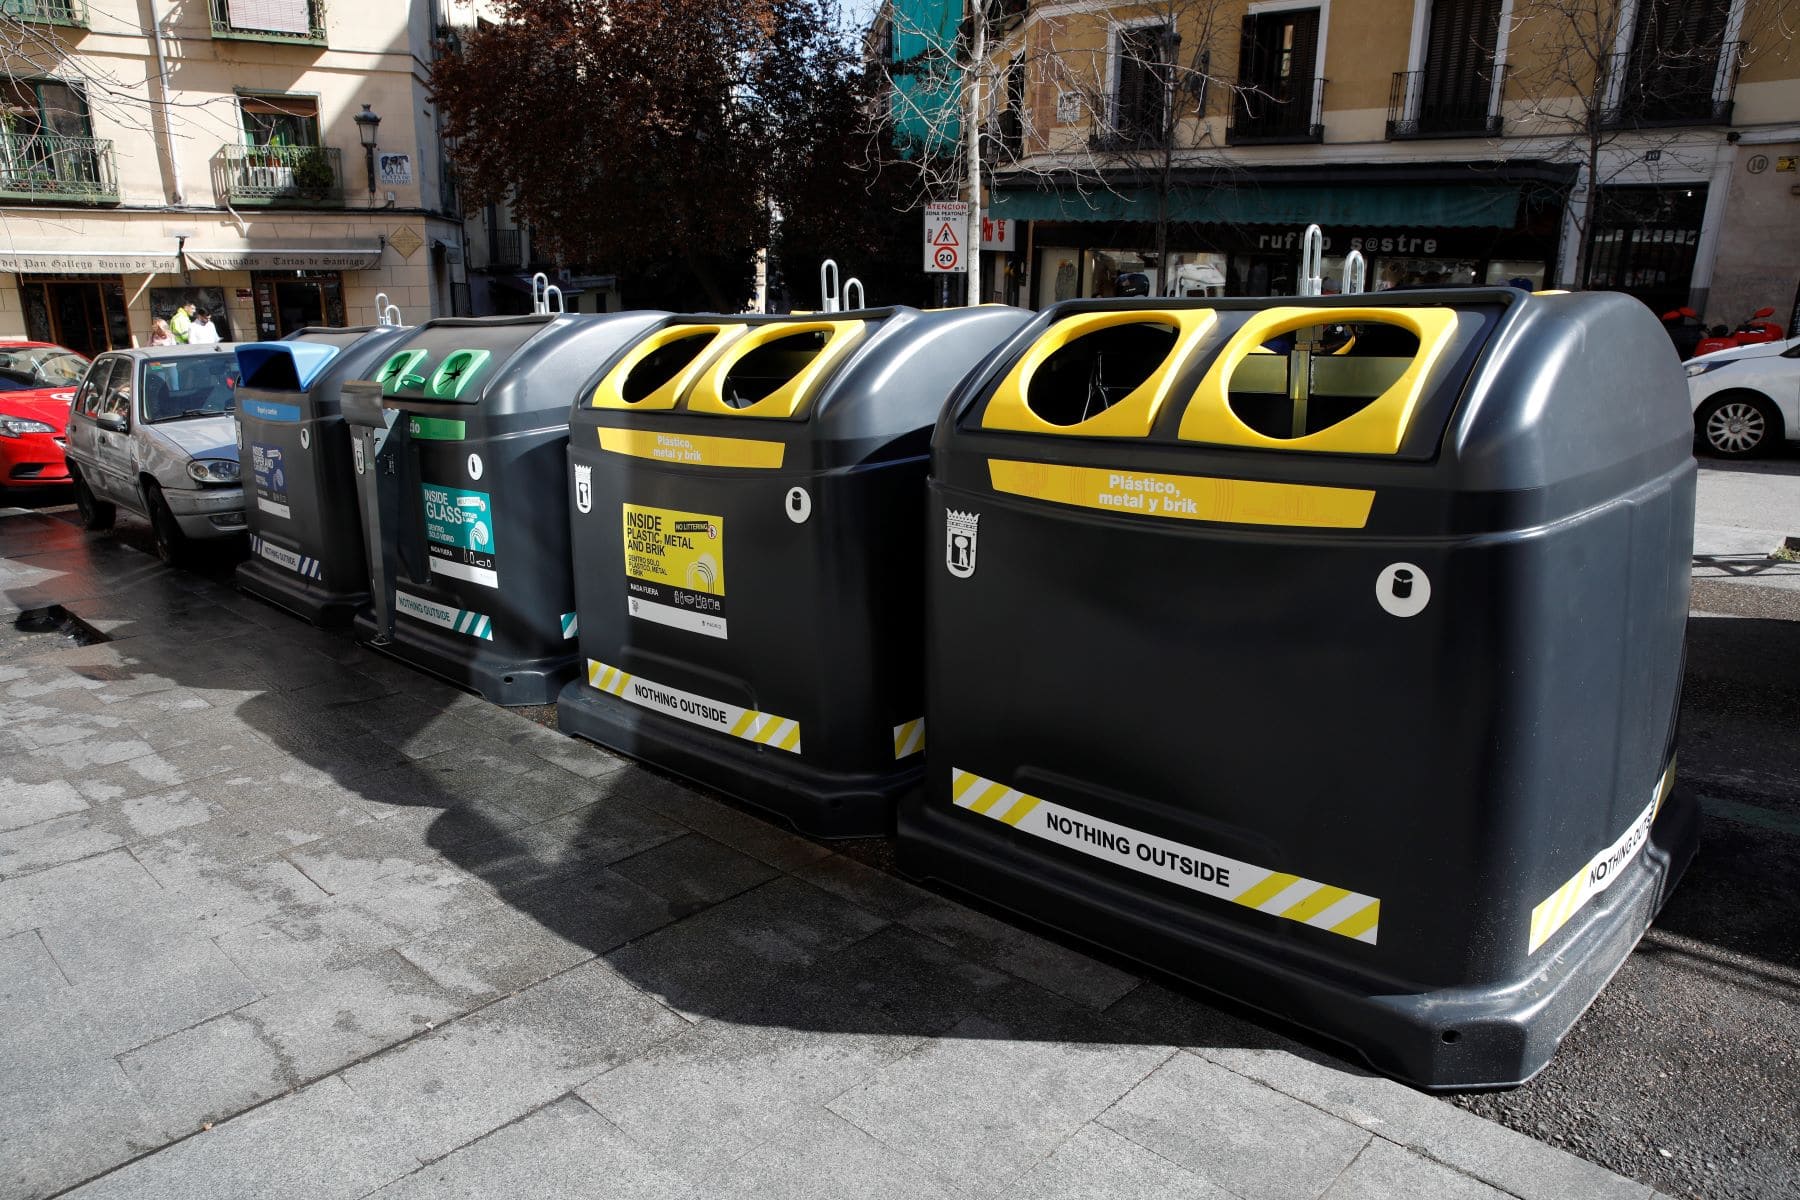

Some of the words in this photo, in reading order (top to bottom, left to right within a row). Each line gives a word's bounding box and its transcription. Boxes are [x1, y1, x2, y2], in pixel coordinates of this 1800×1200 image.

[1259, 232, 1330, 250] rufio
[1350, 234, 1436, 252] s@stre
[24, 258, 46, 270] Pan
[51, 258, 93, 269] Gallego
[136, 260, 146, 269] de
[323, 256, 365, 266] Santiago
[653, 448, 675, 458] metal
[685, 450, 702, 461] brik
[1109, 474, 1180, 498] Plástico,
[424, 489, 449, 506] INSIDE
[1098, 491, 1143, 509] metal
[1149, 498, 1159, 512] y
[1163, 496, 1198, 514] brik
[426, 502, 462, 524] GLASS
[627, 512, 662, 531] INSIDE
[627, 528, 662, 544] PLASTIC,
[664, 533, 694, 549] METAL
[628, 540, 644, 552] AND
[646, 542, 665, 556] BRIK
[399, 596, 424, 614] NOTHING
[424, 606, 451, 622] OUTSIDE
[634, 683, 678, 709] NOTHING
[680, 698, 728, 725] OUTSIDE
[1047, 811, 1130, 856] NOTHING
[1136, 843, 1230, 888] OUTSIDE
[1589, 837, 1632, 888] NOTHING
